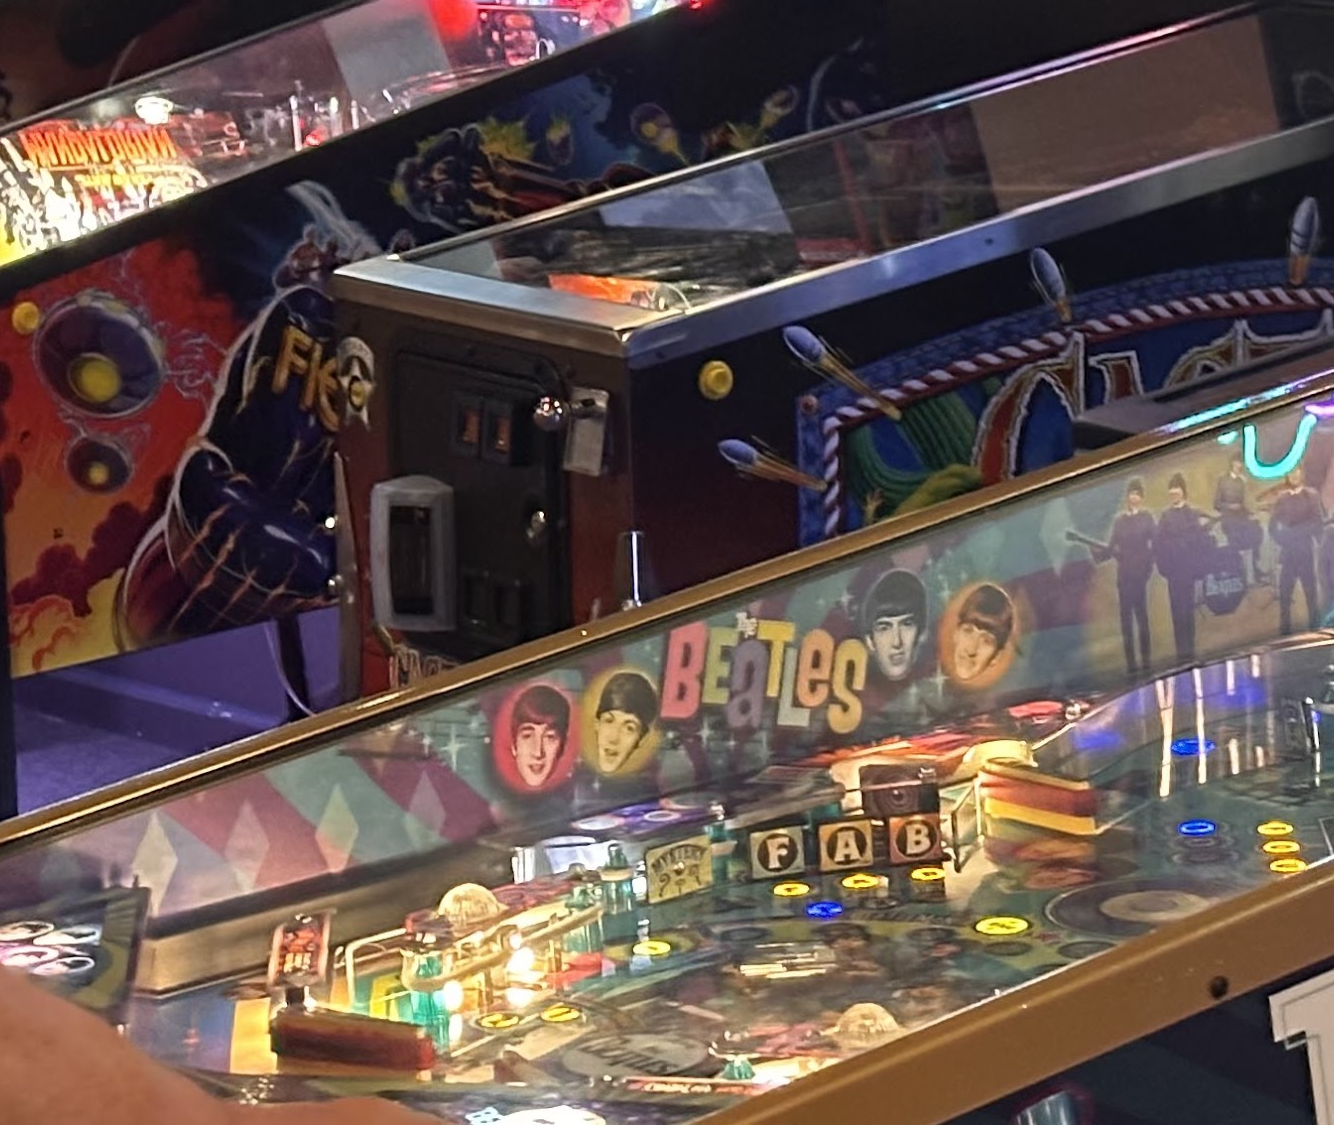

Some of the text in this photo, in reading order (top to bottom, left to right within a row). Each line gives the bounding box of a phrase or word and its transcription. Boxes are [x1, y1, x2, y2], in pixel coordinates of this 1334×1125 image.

[767, 818, 935, 870] F A B
